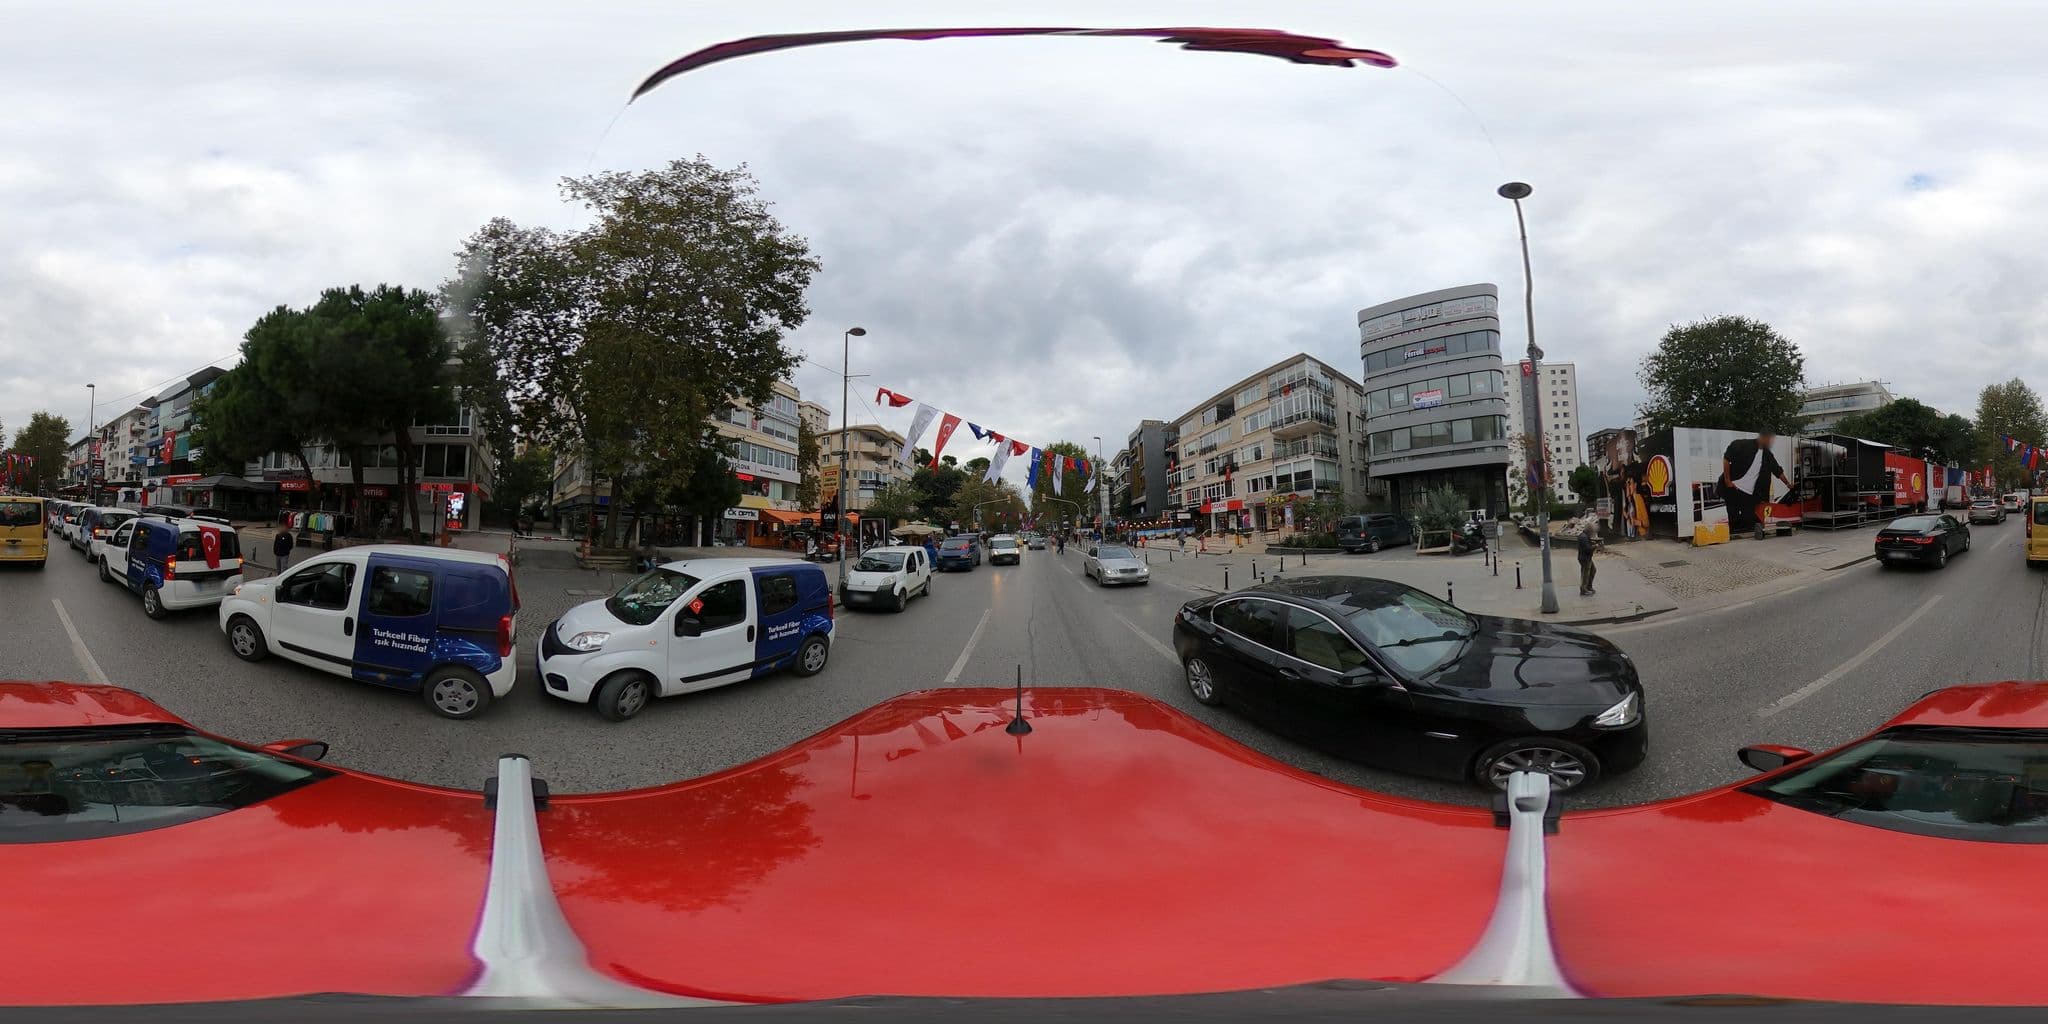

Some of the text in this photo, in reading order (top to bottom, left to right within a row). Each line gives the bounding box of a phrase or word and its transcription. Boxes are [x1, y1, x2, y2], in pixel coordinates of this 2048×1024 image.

[373, 628, 430, 644] Turkcell Fiber
[391, 640, 428, 653] hızında!
